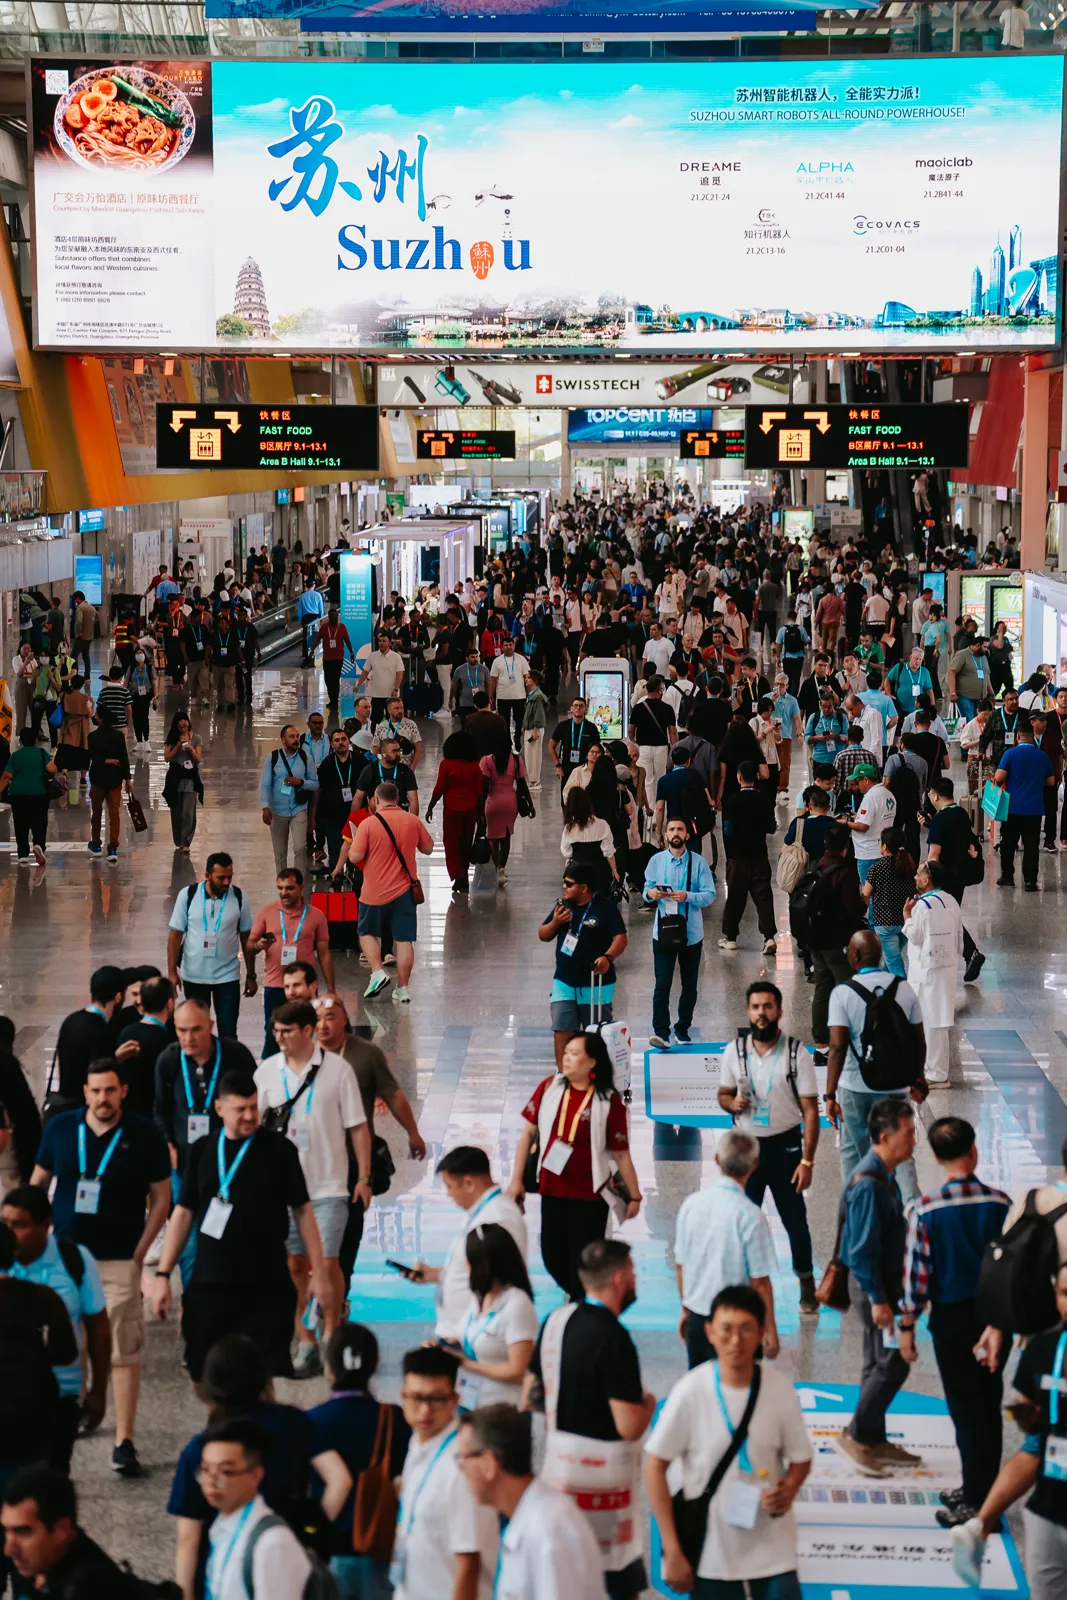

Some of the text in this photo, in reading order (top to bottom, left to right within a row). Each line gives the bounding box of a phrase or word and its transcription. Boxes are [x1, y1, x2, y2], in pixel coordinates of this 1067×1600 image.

[690, 107, 965, 122] SUZHOU SMART ROBOTS ALL-ROUND POWERHOUSE!
[266, 95, 430, 222] 苏州
[680, 162, 742, 172] DREAME
[796, 162, 855, 173] ALPHA
[924, 190, 963, 198] 21.2B41-44
[744, 229, 791, 239] 知行机器人
[555, 379, 640, 390] SWISSTECH
[259, 411, 291, 421] 快餐区
[848, 410, 881, 420] 快餐区
[259, 426, 312, 435] FAST FOOD
[848, 426, 901, 435] FAST FOOD
[260, 442, 292, 451] B区展厅
[848, 442, 881, 450] B区展厅
[259, 457, 279, 466] Area
[281, 457, 288, 466] B
[290, 457, 306, 466] Hall
[848, 457, 868, 466] Area
[870, 457, 876, 466] B
[878, 457, 894, 466] Hall
